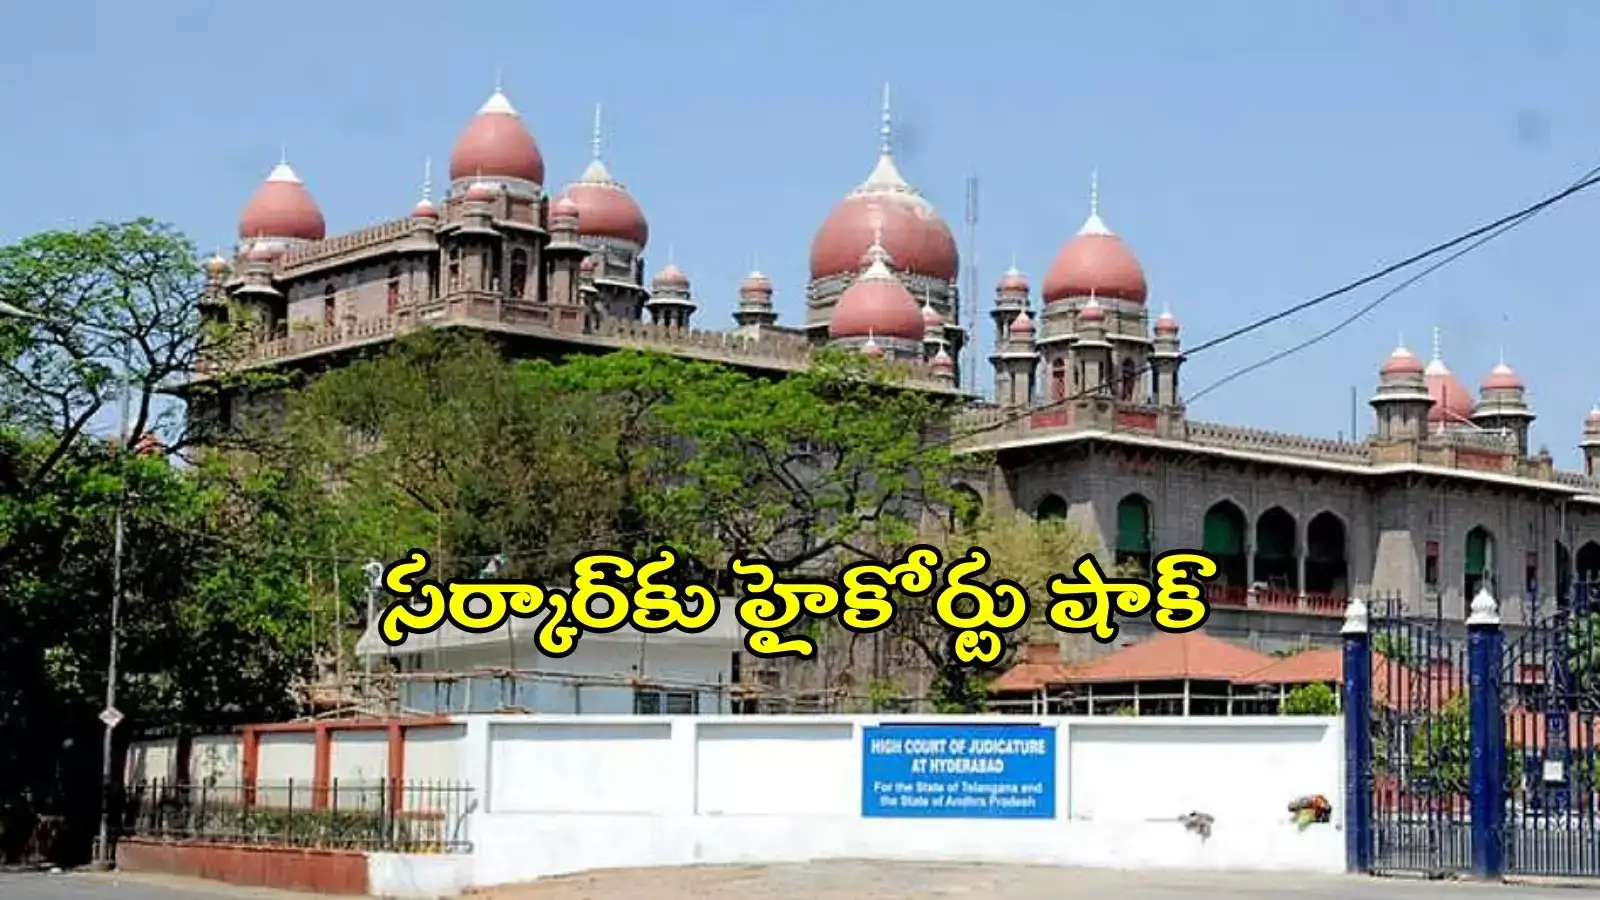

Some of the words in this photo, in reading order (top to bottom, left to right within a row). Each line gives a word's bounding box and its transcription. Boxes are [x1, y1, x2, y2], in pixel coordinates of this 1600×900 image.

[871, 738, 902, 754] HIGH
[904, 738, 946, 754] COURT
[948, 738, 966, 754] OF
[969, 738, 1045, 755] JUDICATURE
[911, 757, 927, 774] AT
[929, 757, 1004, 774] HYDERABAD
[874, 781, 892, 793] For
[894, 781, 914, 793] the
[916, 781, 945, 793] State
[946, 781, 959, 793] of
[961, 781, 1018, 795] Telangana
[880, 795, 898, 808] the
[901, 794, 929, 808] State
[931, 795, 944, 807] of
[945, 795, 986, 808] Andhra
[989, 795, 1037, 809] Pradesh
